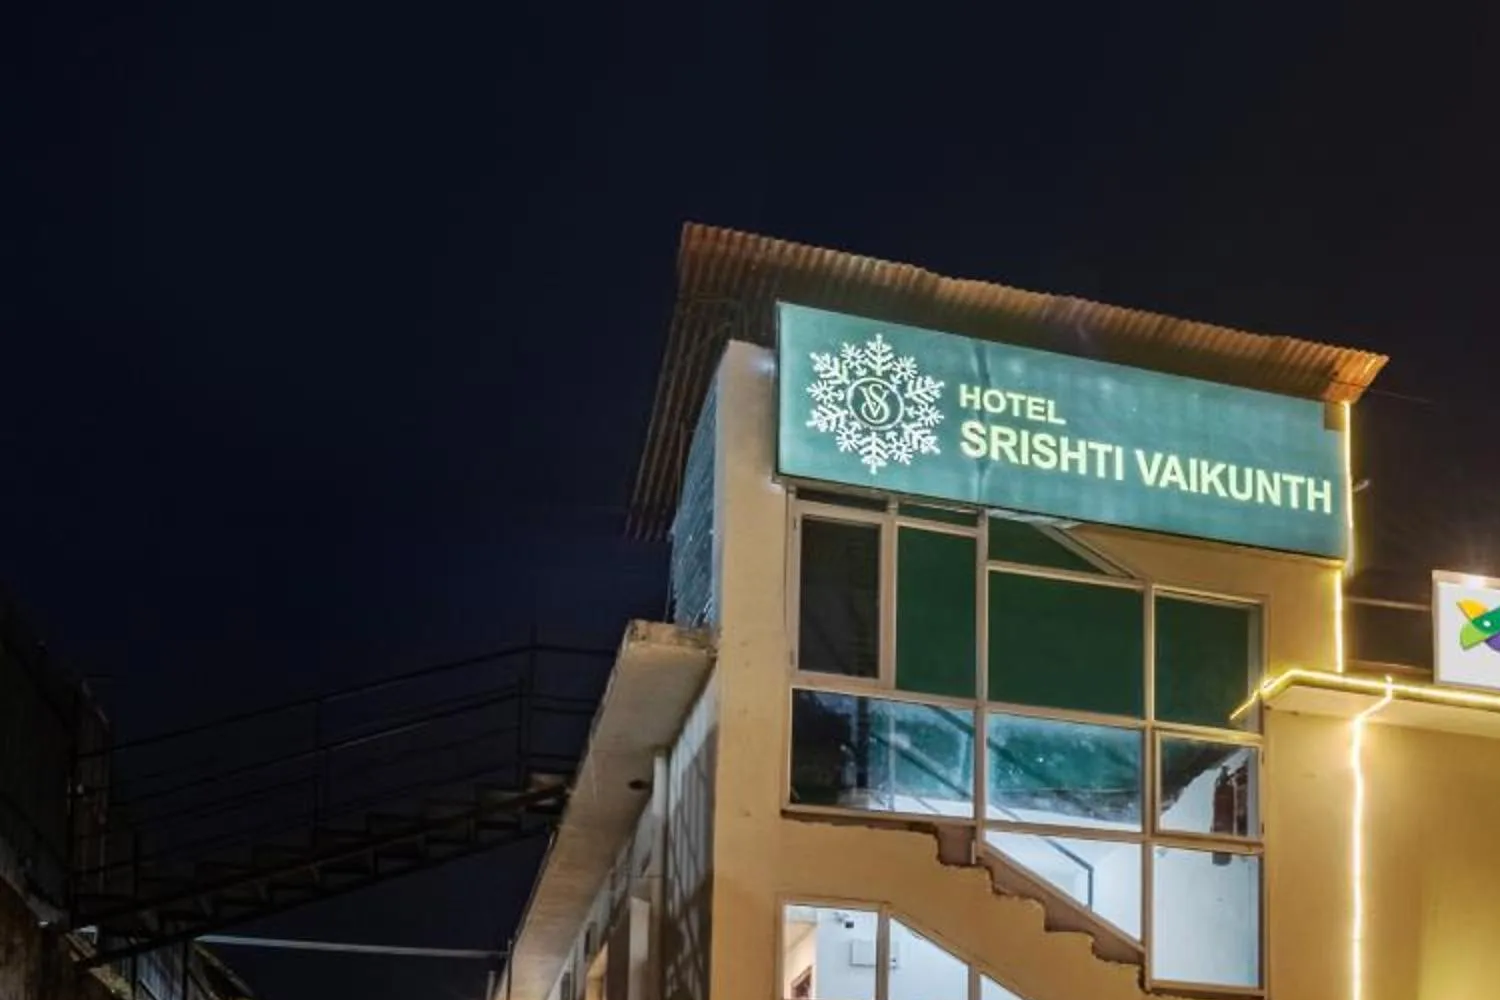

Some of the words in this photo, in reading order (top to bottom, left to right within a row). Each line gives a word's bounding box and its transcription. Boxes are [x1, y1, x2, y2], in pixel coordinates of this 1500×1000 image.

[959, 384, 1066, 425] HOTEL
[959, 419, 1124, 481] SRISHTI
[1135, 449, 1332, 514] VAIKUNTH
